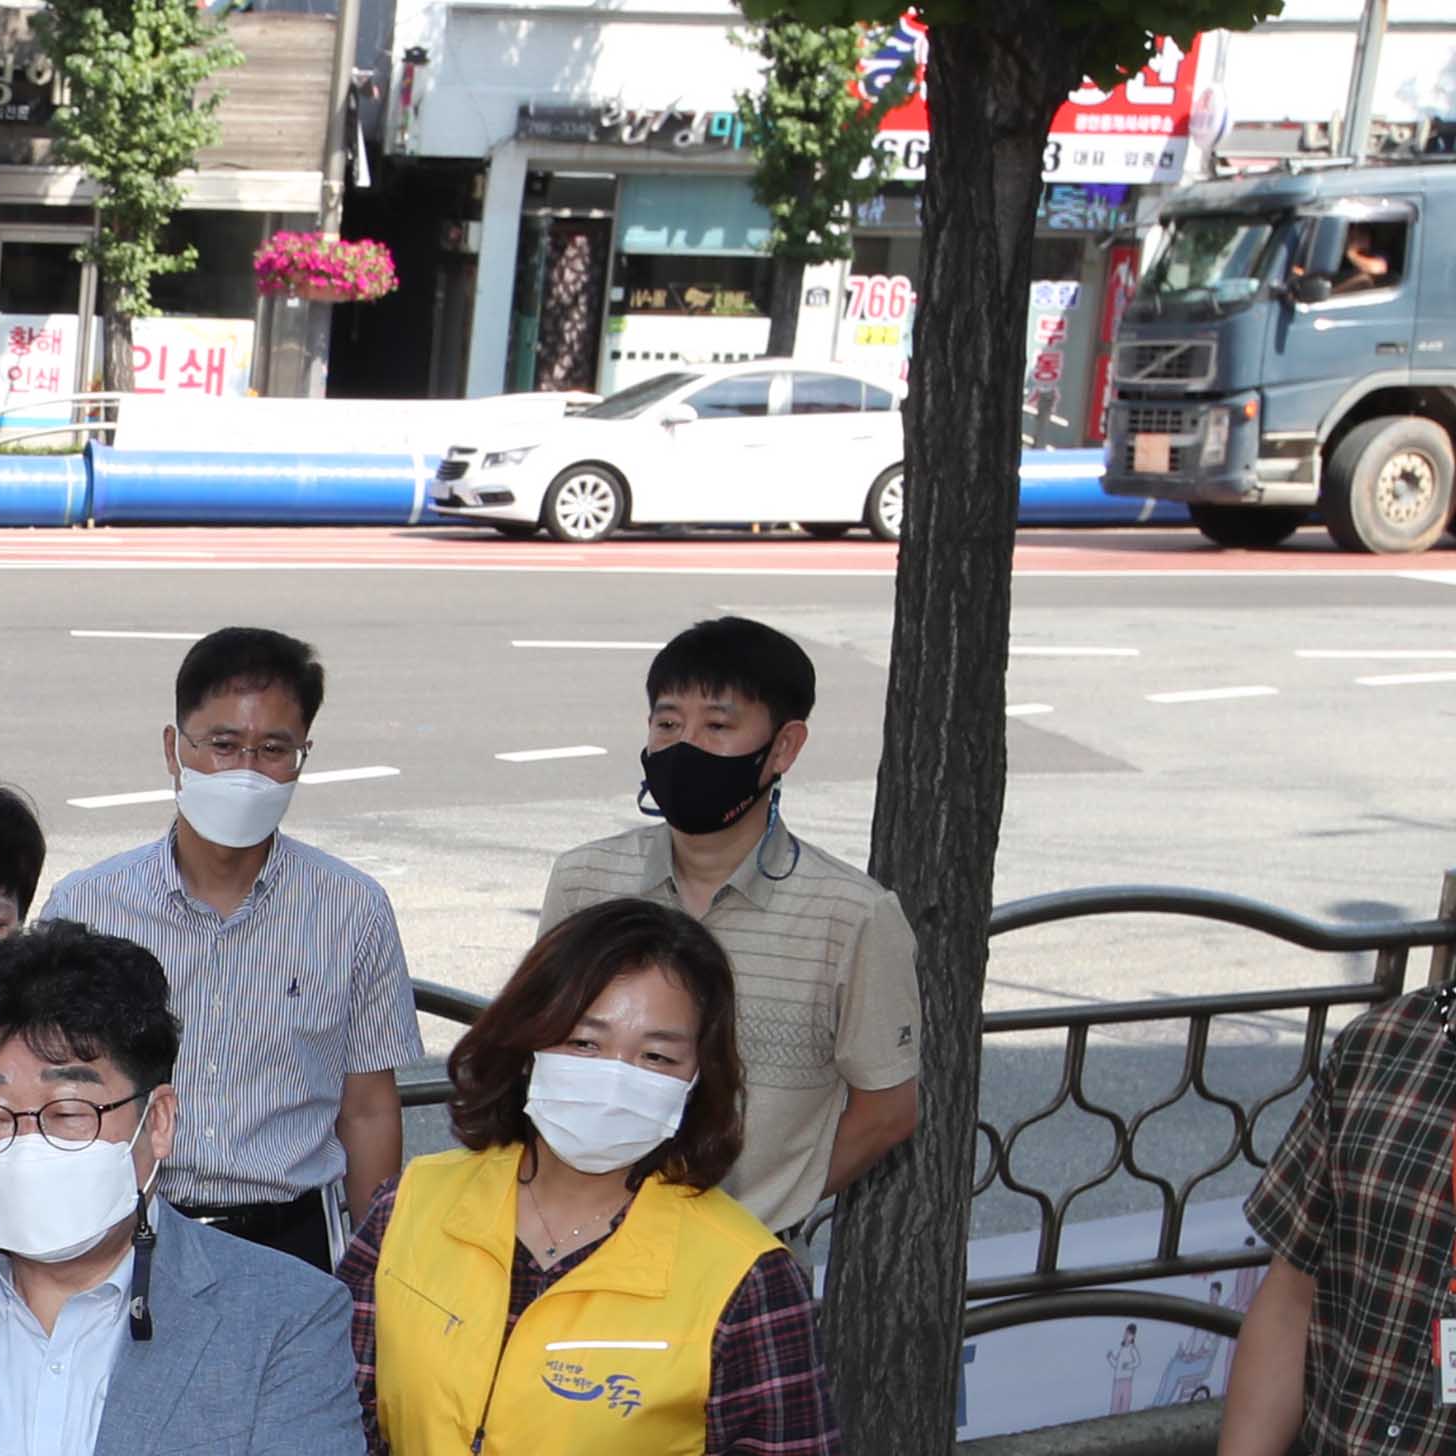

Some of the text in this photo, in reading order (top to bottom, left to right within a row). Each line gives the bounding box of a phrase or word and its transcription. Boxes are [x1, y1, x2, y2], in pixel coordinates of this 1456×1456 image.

[9, 326, 64, 357] 황해
[7, 365, 61, 394] 인쇄
[129, 344, 227, 397] 인쇄
[606, 1374, 642, 1418] 동구
